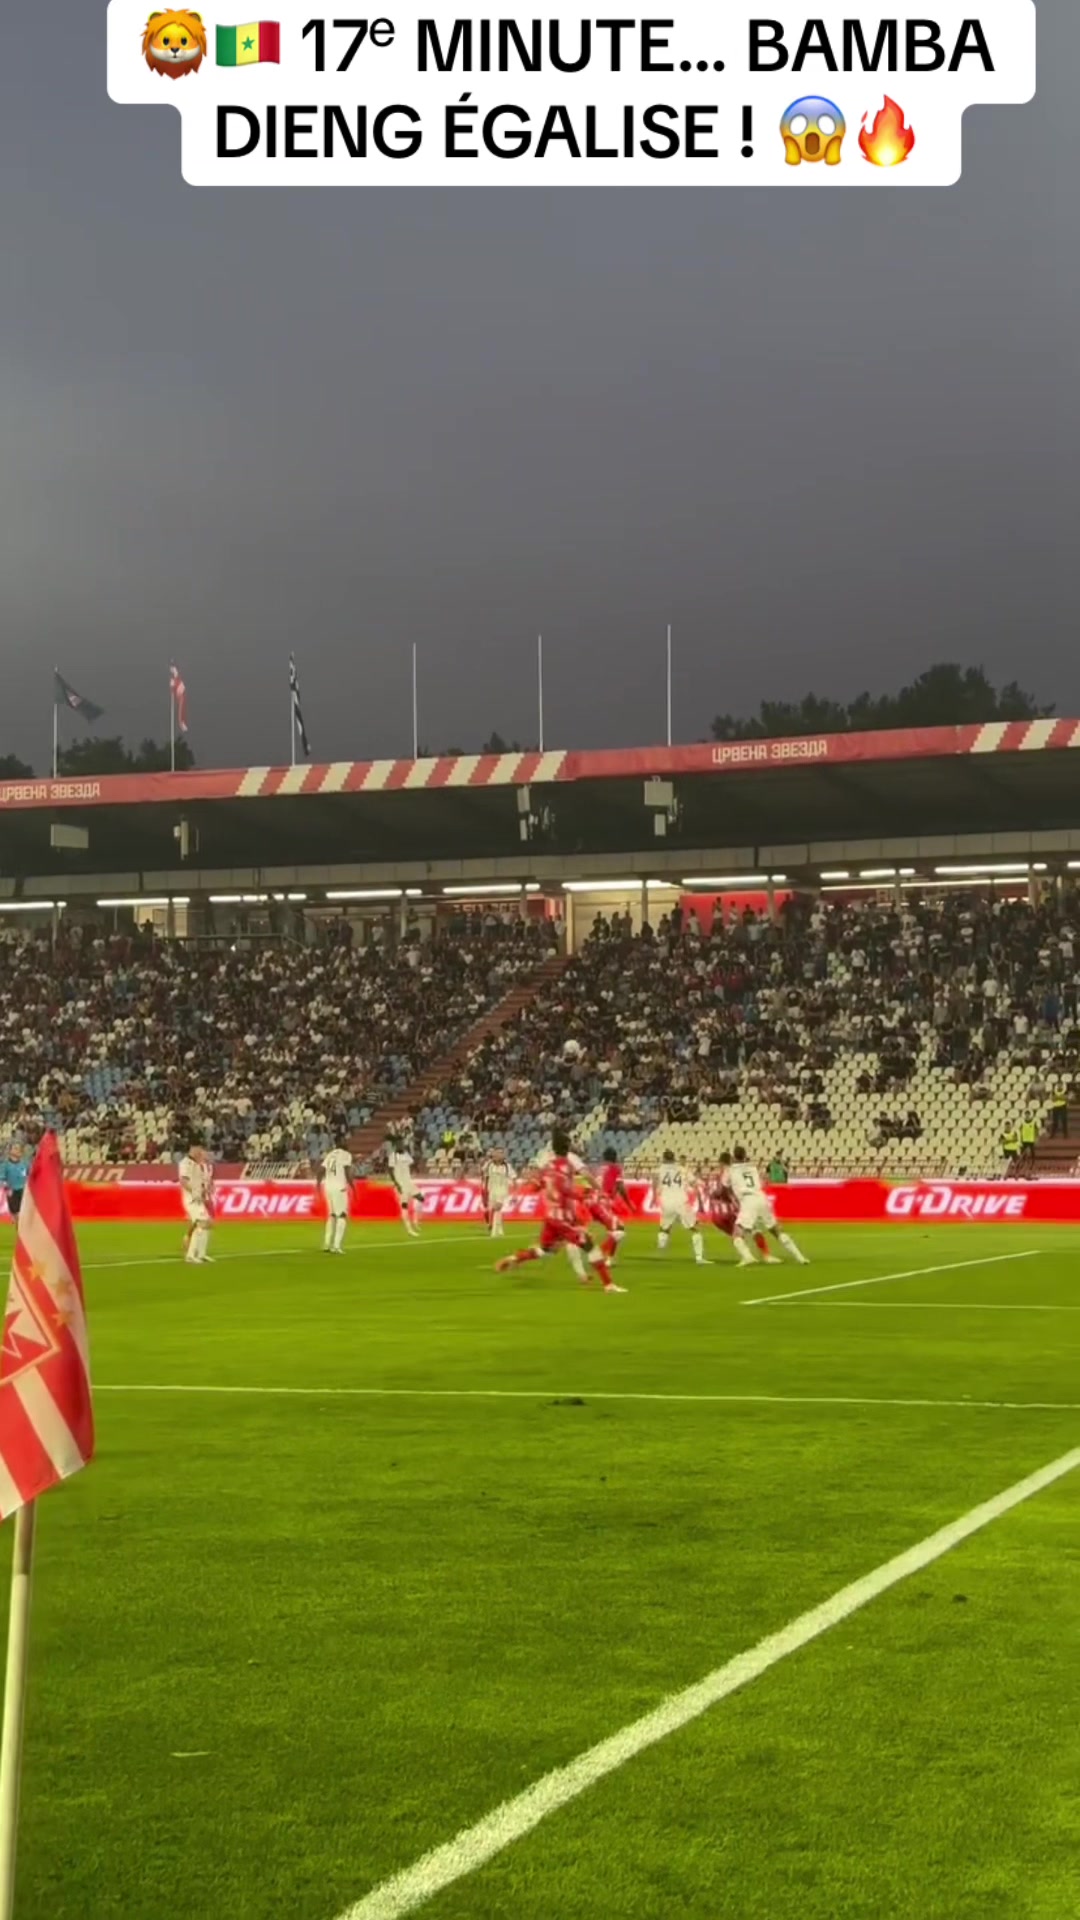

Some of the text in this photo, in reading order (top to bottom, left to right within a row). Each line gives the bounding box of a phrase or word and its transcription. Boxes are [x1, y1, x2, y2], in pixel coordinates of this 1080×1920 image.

[712, 740, 827, 763] ЦРВЕНА ЗВЕЗДА
[51, 782, 100, 799] ЗВЕЗДА
[662, 1172, 682, 1187] 44
[742, 1171, 755, 1188] 5
